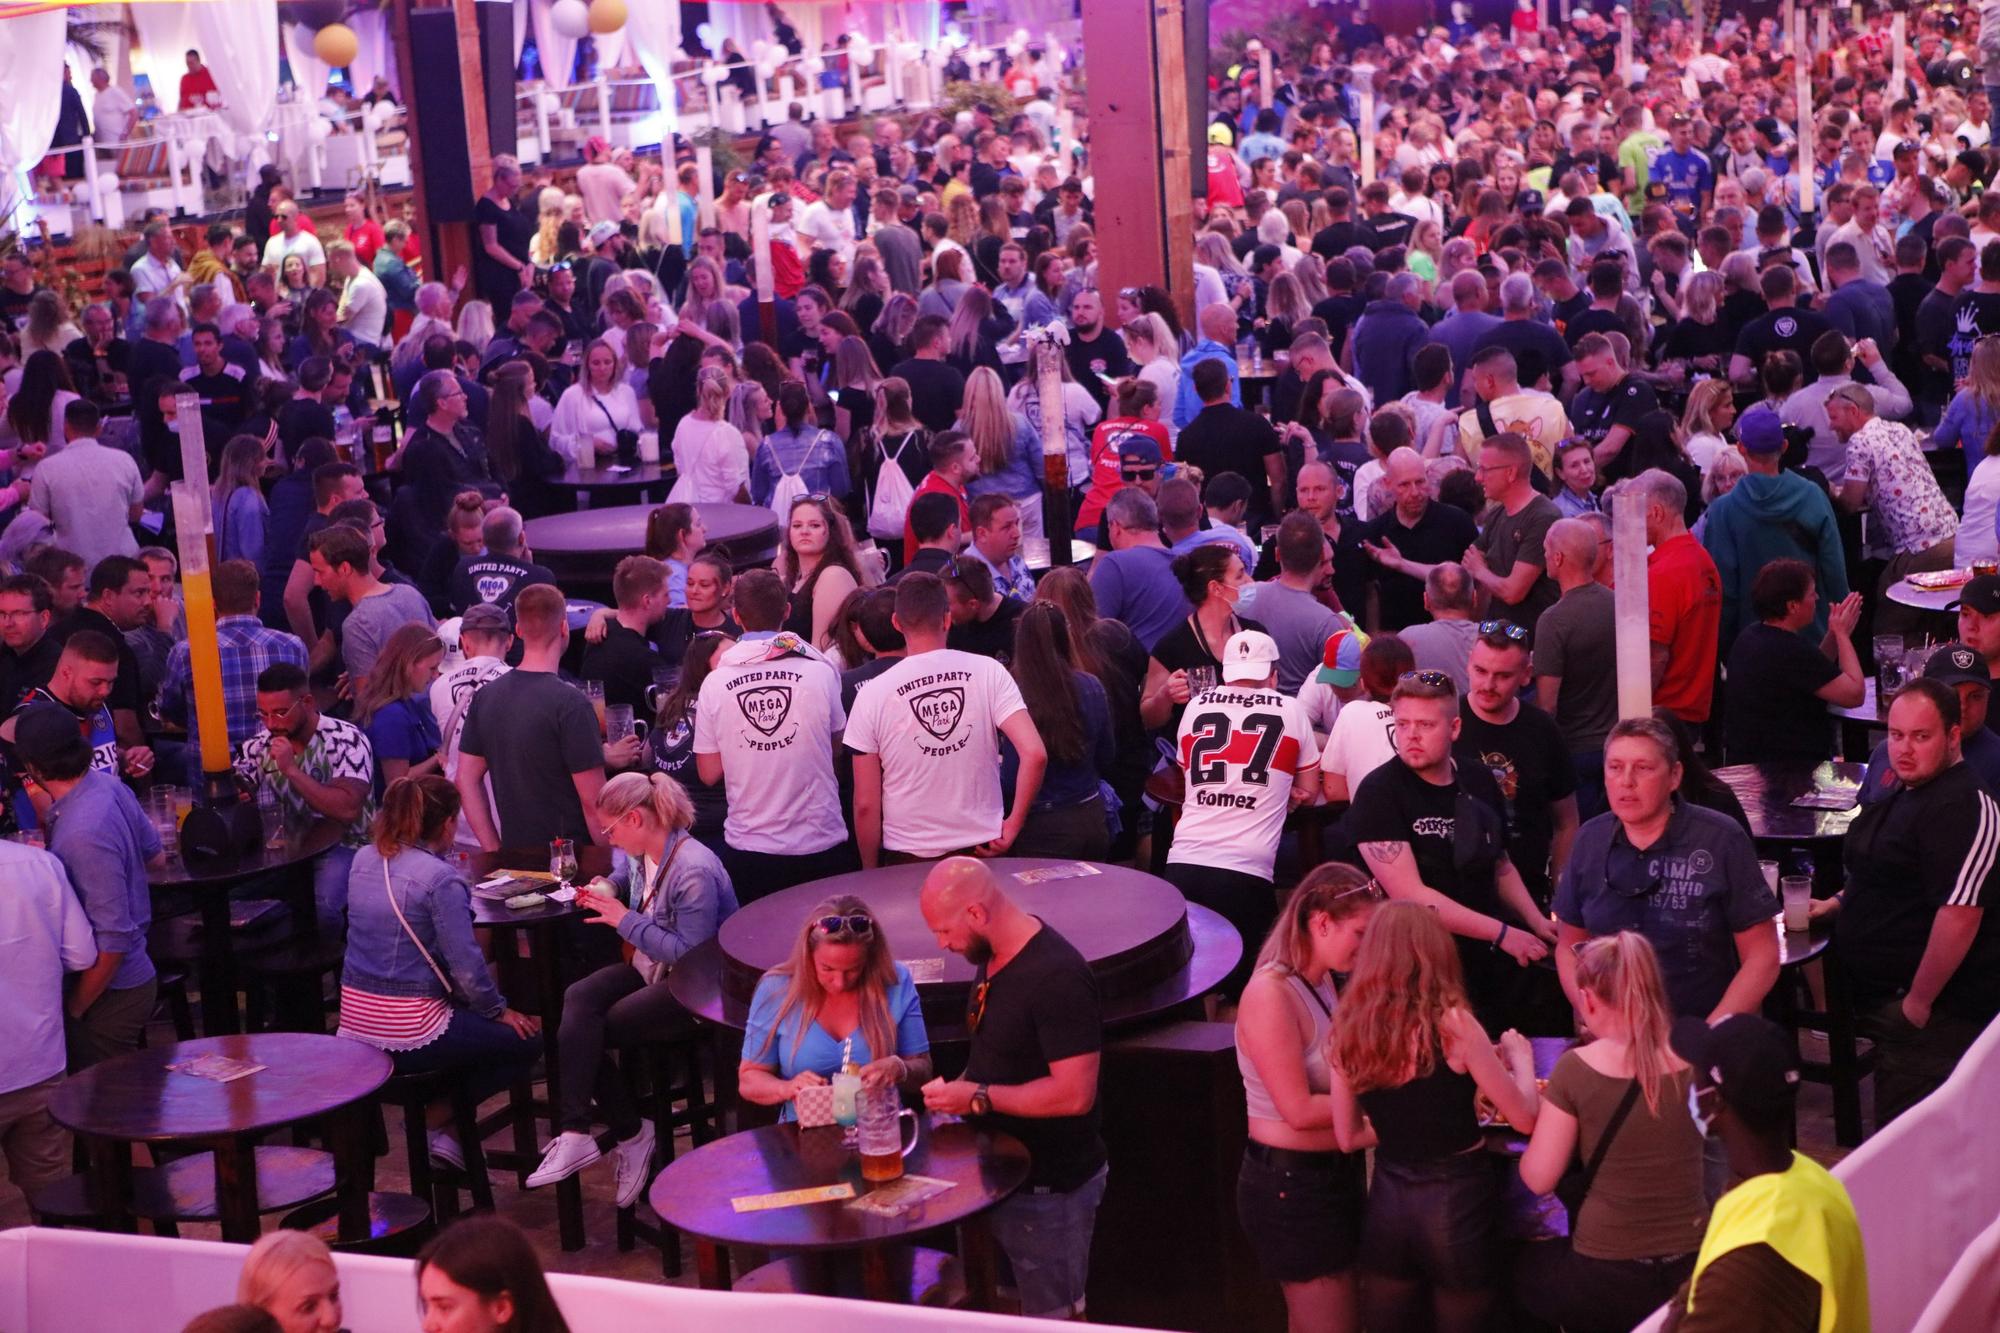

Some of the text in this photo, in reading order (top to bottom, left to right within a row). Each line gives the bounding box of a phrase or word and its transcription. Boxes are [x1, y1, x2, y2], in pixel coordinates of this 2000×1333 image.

[468, 563, 528, 576] UNITED PARTY
[449, 667, 478, 682] UNITED
[725, 671, 803, 691] UNITED PARTY
[896, 671, 972, 696] UNITED PARTY
[748, 698, 783, 713] MEGA
[1198, 688, 1283, 708] Stuttgart
[758, 710, 777, 722] Park
[922, 700, 958, 718] MEGA
[932, 714, 951, 727] Park
[749, 736, 793, 751] PEOPLE
[923, 739, 966, 756] PEOPLE
[1190, 712, 1285, 787] 27
[1197, 790, 1257, 810] Gomez
[1648, 894, 1687, 909] 19/63
